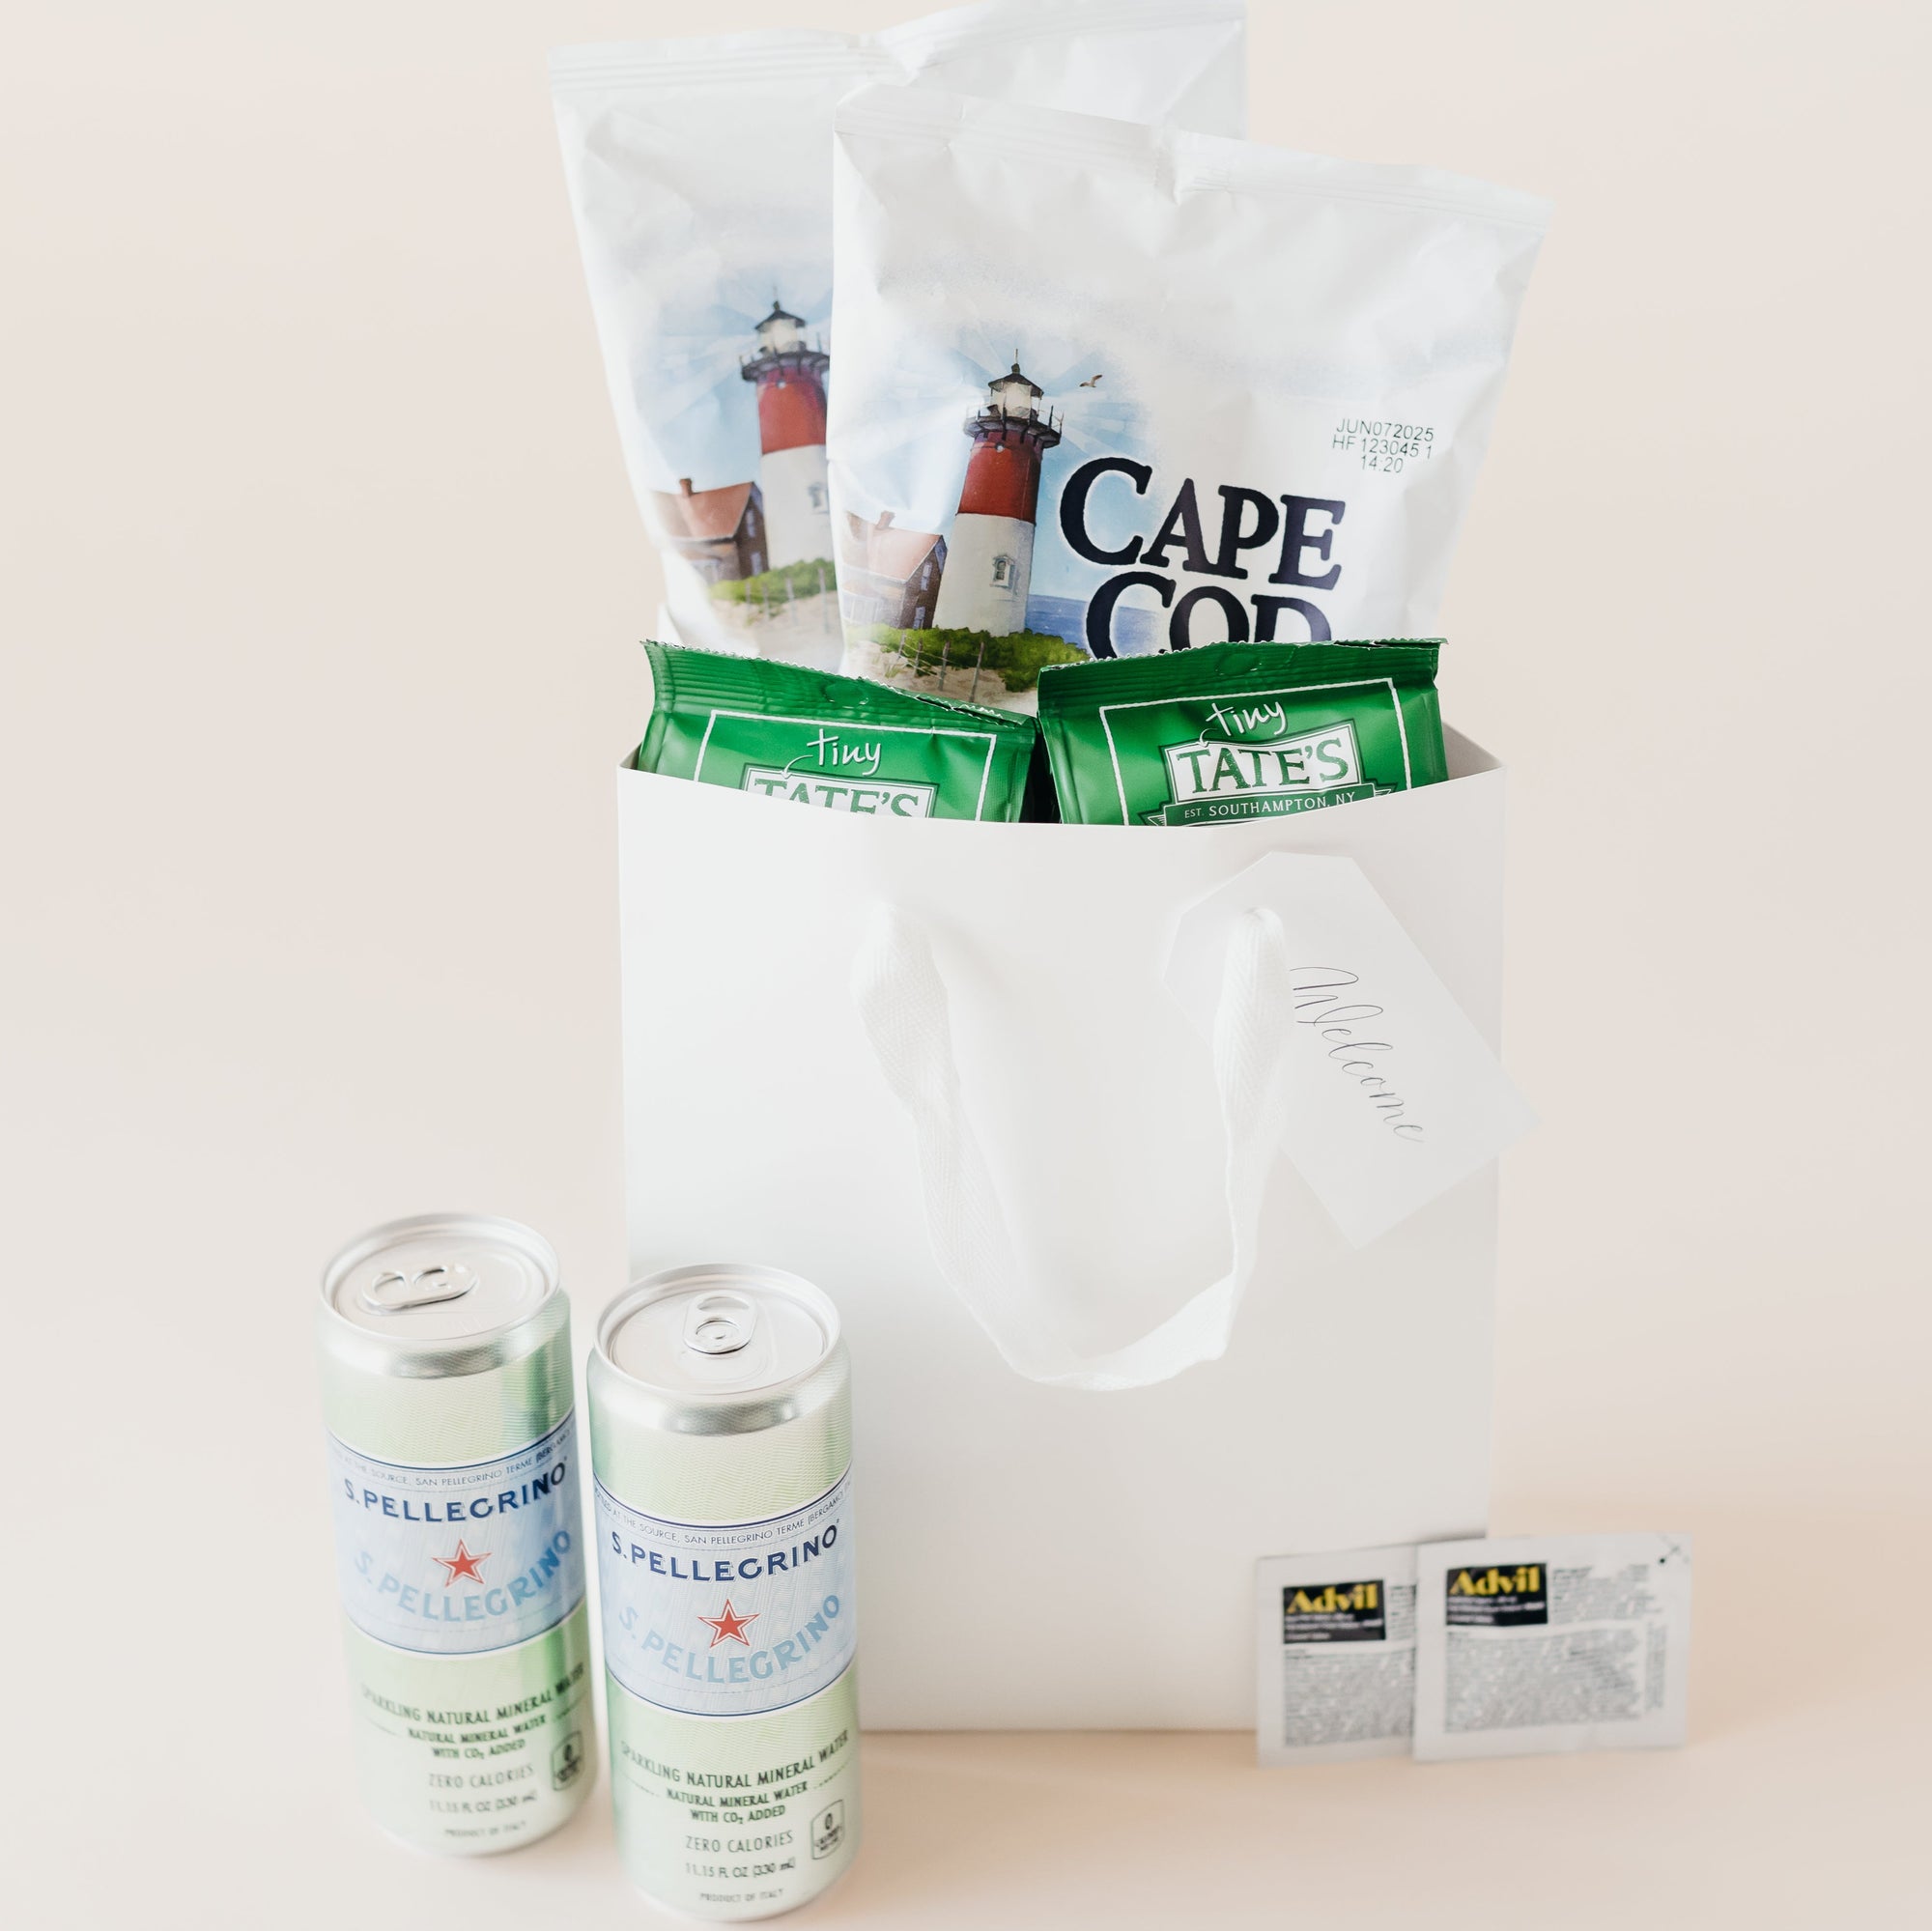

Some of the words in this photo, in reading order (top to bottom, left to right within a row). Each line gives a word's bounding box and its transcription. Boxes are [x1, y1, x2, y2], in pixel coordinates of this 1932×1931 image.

[1336, 418, 1435, 442] JUN072025
[1332, 434, 1356, 450] HF
[1361, 438, 1419, 458] 123045
[1361, 454, 1404, 473] 14:20
[1060, 456, 1346, 590] CAPE
[1085, 571, 1333, 659] COD
[1205, 701, 1287, 735] tiny
[806, 727, 881, 777] tiny
[1177, 737, 1350, 794] TATE'S
[1184, 808, 1205, 819] EST.
[1335, 792, 1356, 806] NY
[1289, 966, 1425, 1144] Welcome
[415, 1477, 439, 1487] SAN
[441, 1469, 503, 1487] PELLEGRINO
[684, 1534, 707, 1545] SAN
[710, 1530, 774, 1546] PELLEGRINO
[776, 1518, 805, 1536] TERME
[1449, 1566, 1541, 1596] Advil
[1286, 1583, 1378, 1614] Advil
[427, 1710, 491, 1725] NATURAL
[496, 1690, 554, 1720] MINERAL
[687, 1771, 752, 1789] NATURAL
[757, 1756, 815, 1785] MINERAL
[818, 1729, 848, 1763] WATER
[667, 1788, 716, 1807] NATURAL
[720, 1793, 770, 1807] MINERAL
[773, 1781, 808, 1802] WATER
[690, 1809, 719, 1823] WITH
[748, 1804, 786, 1822] ADDED
[686, 1834, 721, 1853] ZERO
[727, 1830, 794, 1854] CALORIES
